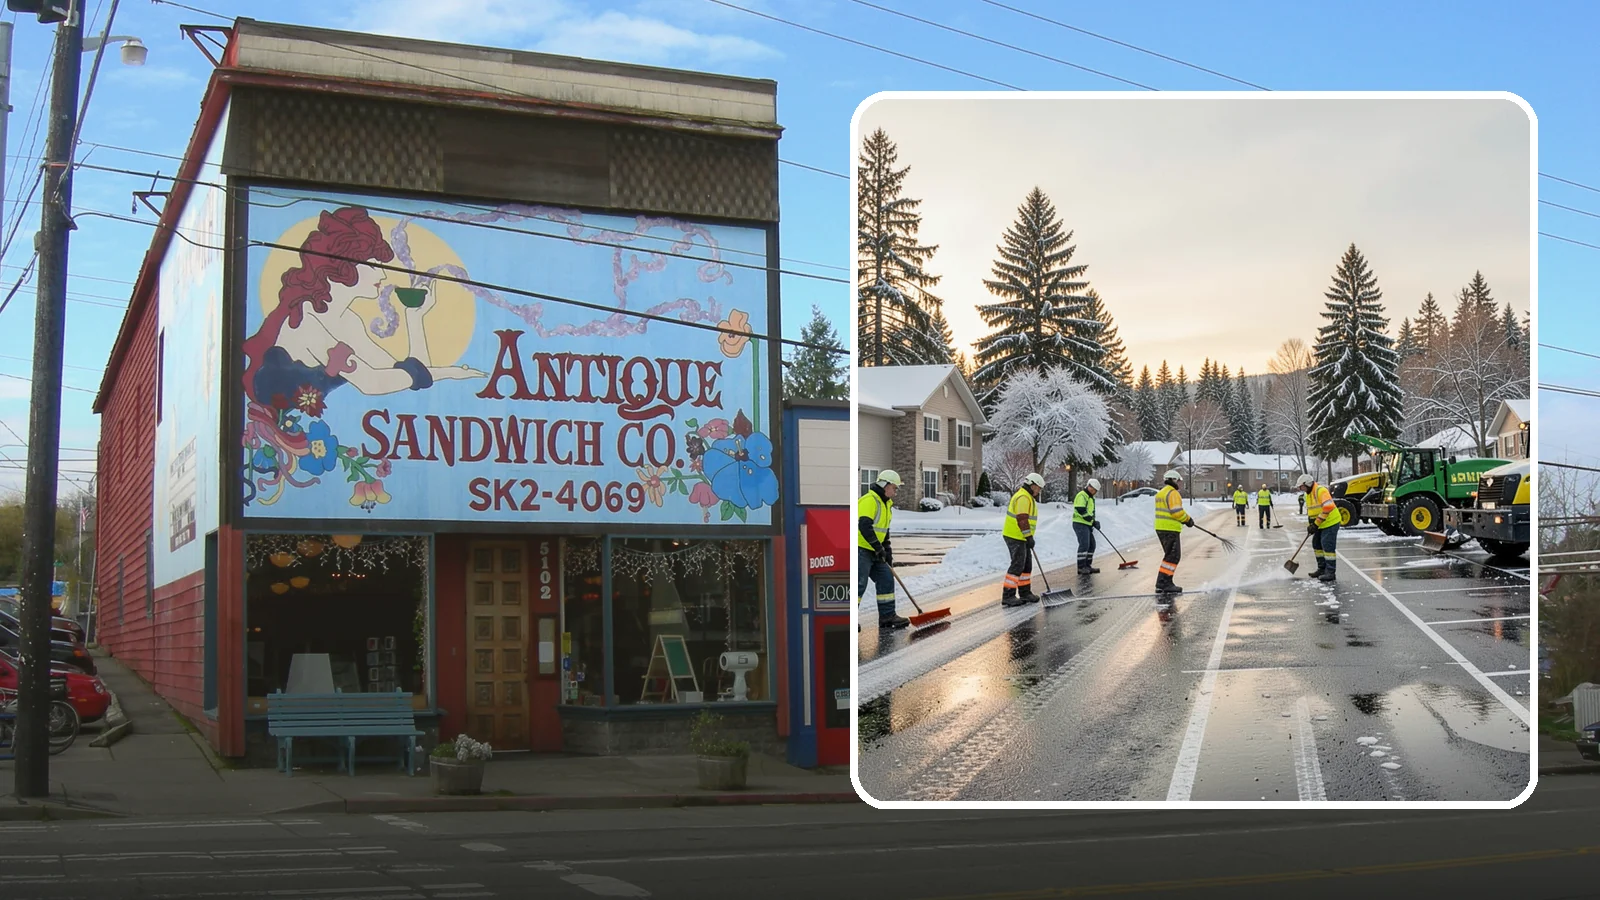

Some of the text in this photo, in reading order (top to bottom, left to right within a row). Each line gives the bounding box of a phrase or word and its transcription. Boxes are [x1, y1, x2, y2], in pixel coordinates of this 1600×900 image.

[476, 329, 723, 421] ANTIQUE
[361, 409, 684, 469] SANDWICH CO.
[469, 477, 645, 513] SK2-4069
[540, 542, 551, 599] 5102
[809, 555, 834, 568] BOOKS
